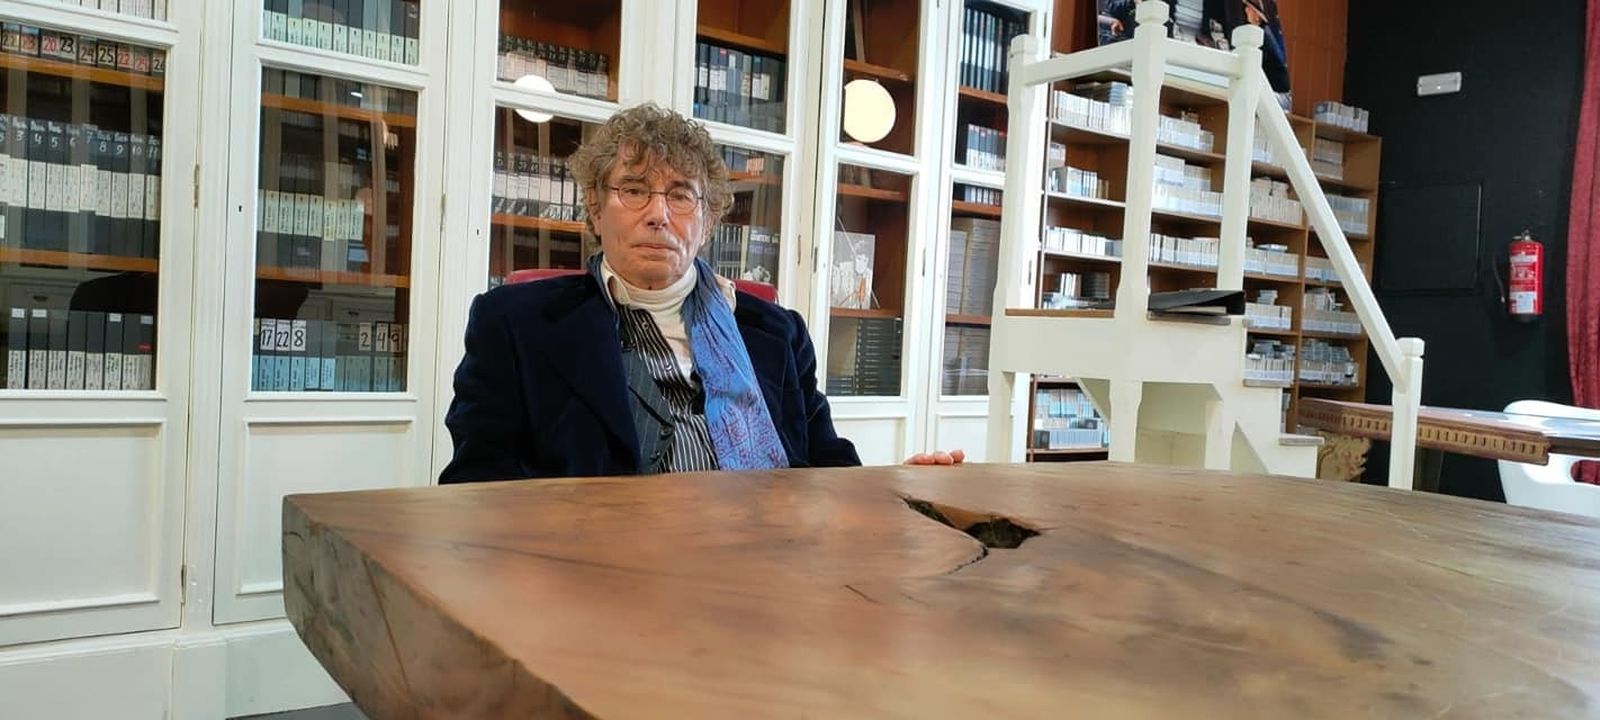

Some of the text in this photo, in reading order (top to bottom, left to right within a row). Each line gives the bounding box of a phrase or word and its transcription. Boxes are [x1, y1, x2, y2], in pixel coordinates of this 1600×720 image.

[99, 47, 114, 63] 25
[34, 133, 43, 145] 4
[51, 136, 59, 149] 5
[99, 141, 107, 153] 8
[116, 144, 124, 156] 9
[261, 328, 273, 346] 17
[276, 331, 289, 348] 22
[294, 329, 304, 347] 8
[360, 332, 370, 348] 2
[376, 332, 386, 350] 4
[391, 333, 400, 351] 9
